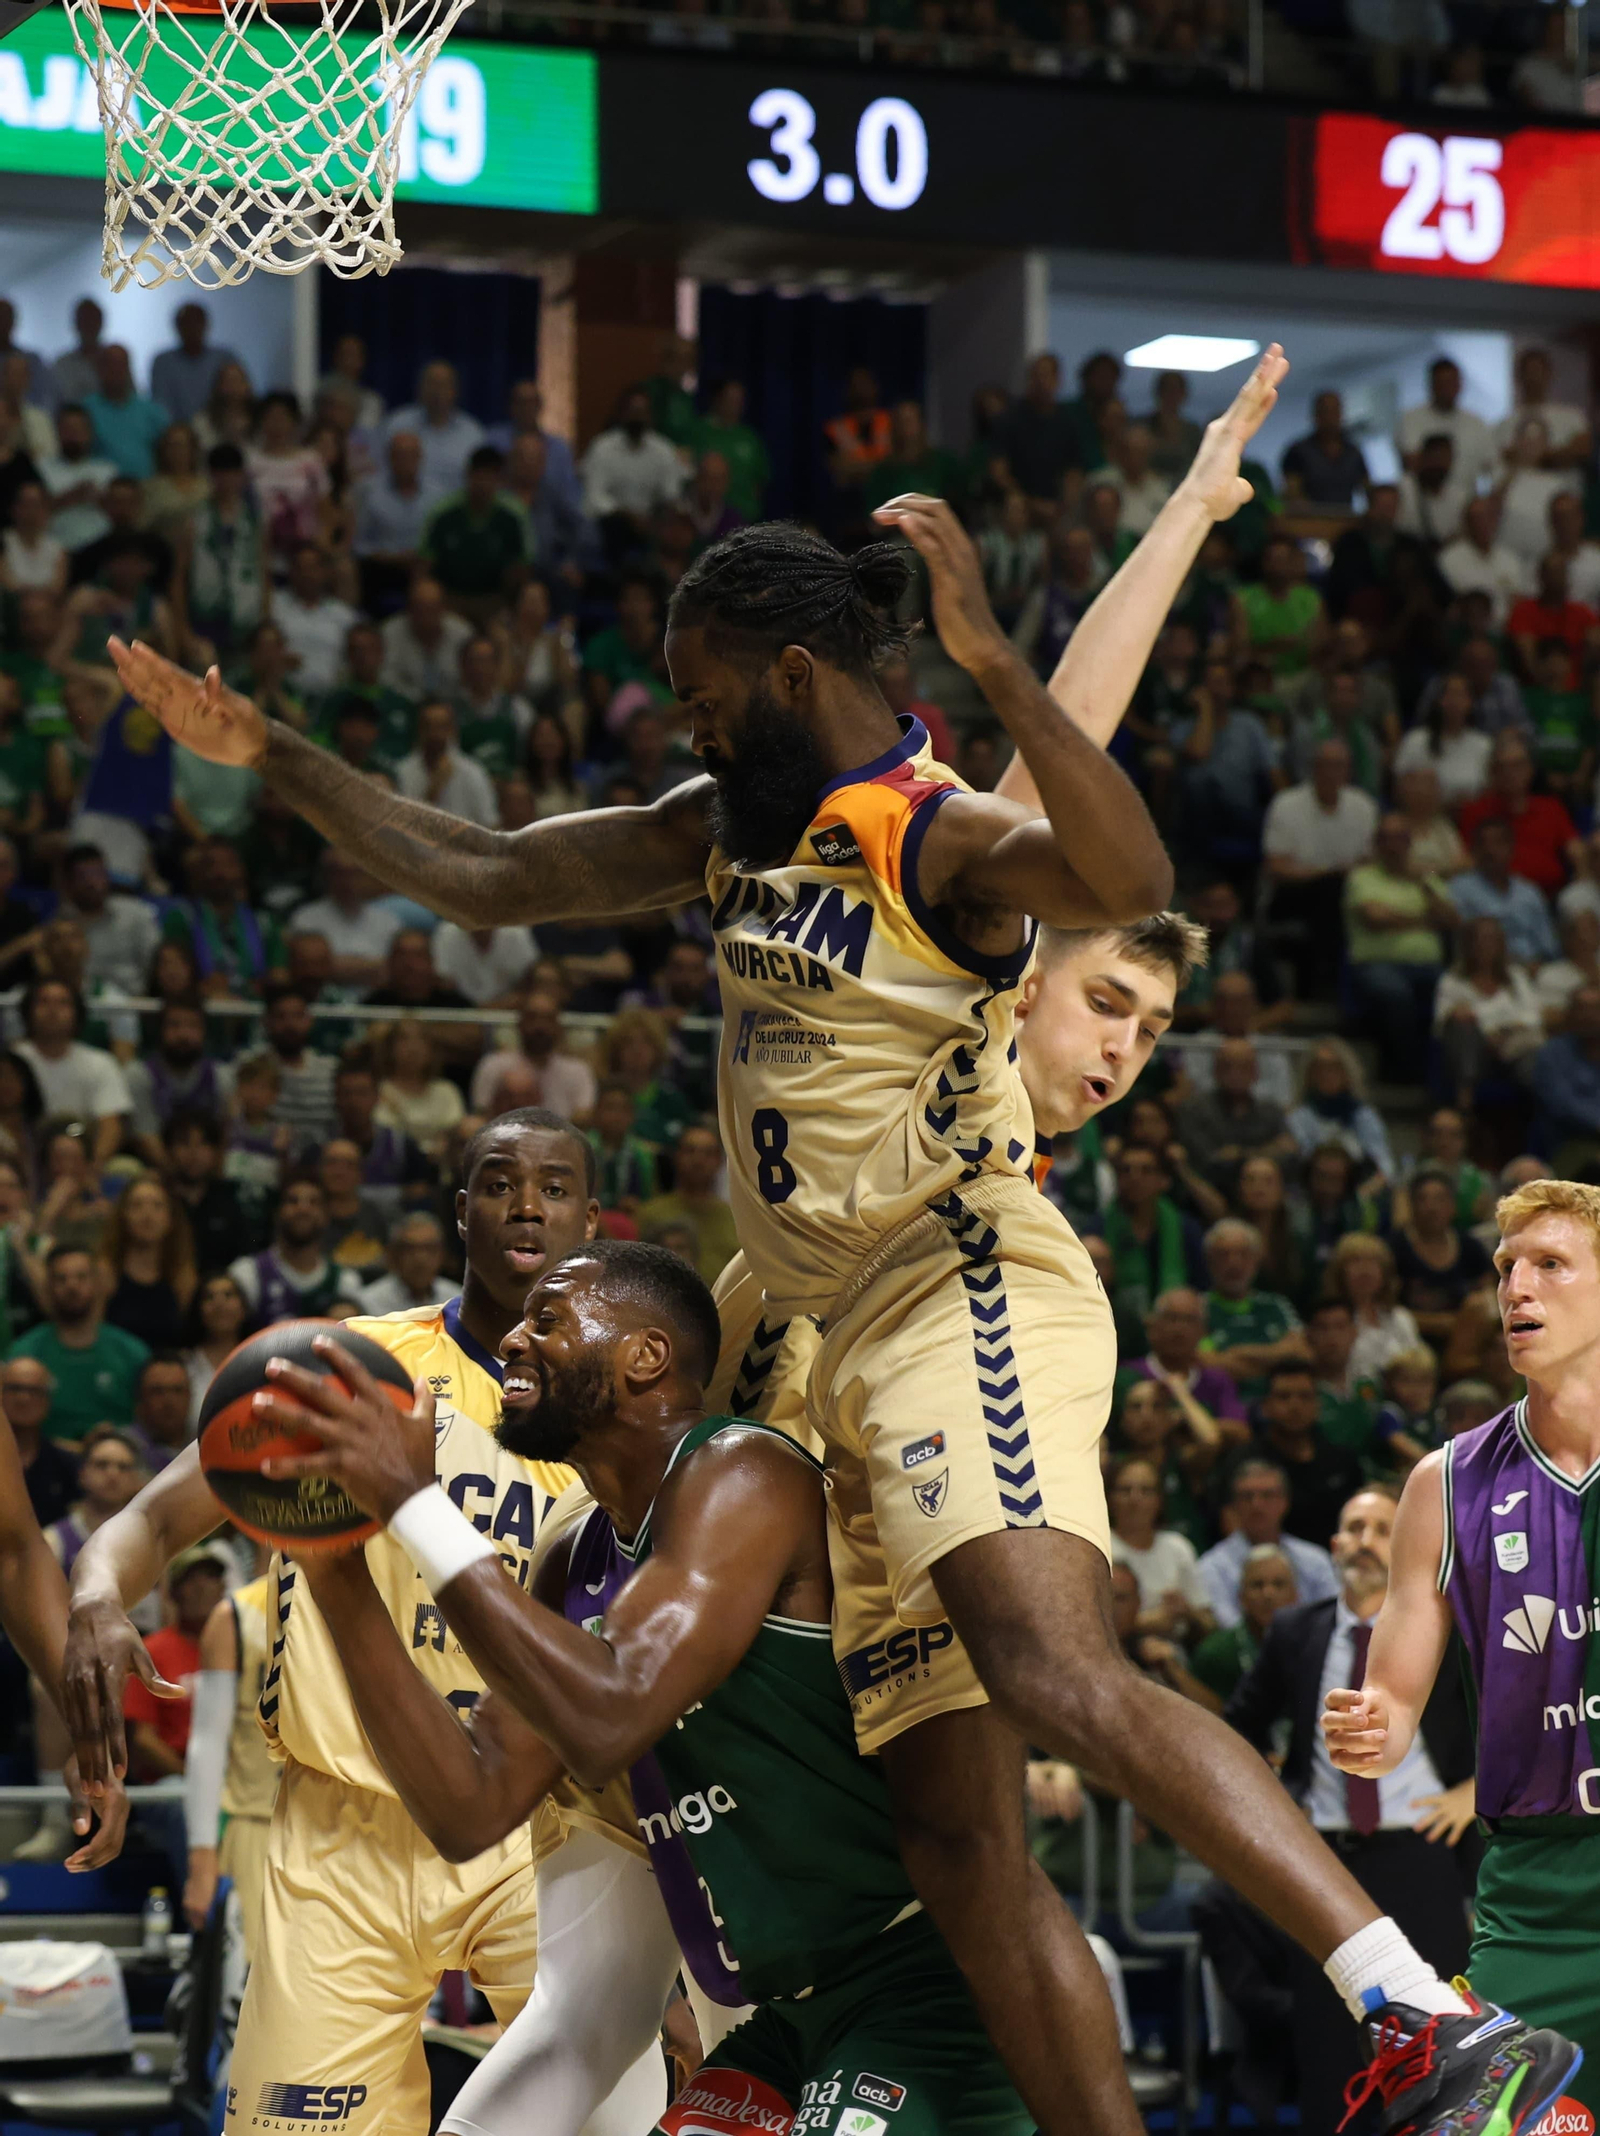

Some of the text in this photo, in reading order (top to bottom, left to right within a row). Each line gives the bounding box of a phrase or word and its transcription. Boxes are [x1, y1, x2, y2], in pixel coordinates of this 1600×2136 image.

[372, 55, 488, 187] 19
[747, 88, 928, 210] 3.0
[1380, 132, 1505, 264] 25
[818, 841, 840, 855] liga
[755, 1031, 837, 1047] DE LA CRUZ 2024
[770, 1049, 812, 1065] JUBILAR
[751, 1107, 797, 1205] 8
[906, 1446, 936, 1465] acb
[846, 1622, 953, 1698] ESP
[276, 2083, 367, 2120] ESP
[859, 2085, 890, 2103] acb
[252, 2117, 346, 2132] SOLUTIONS
